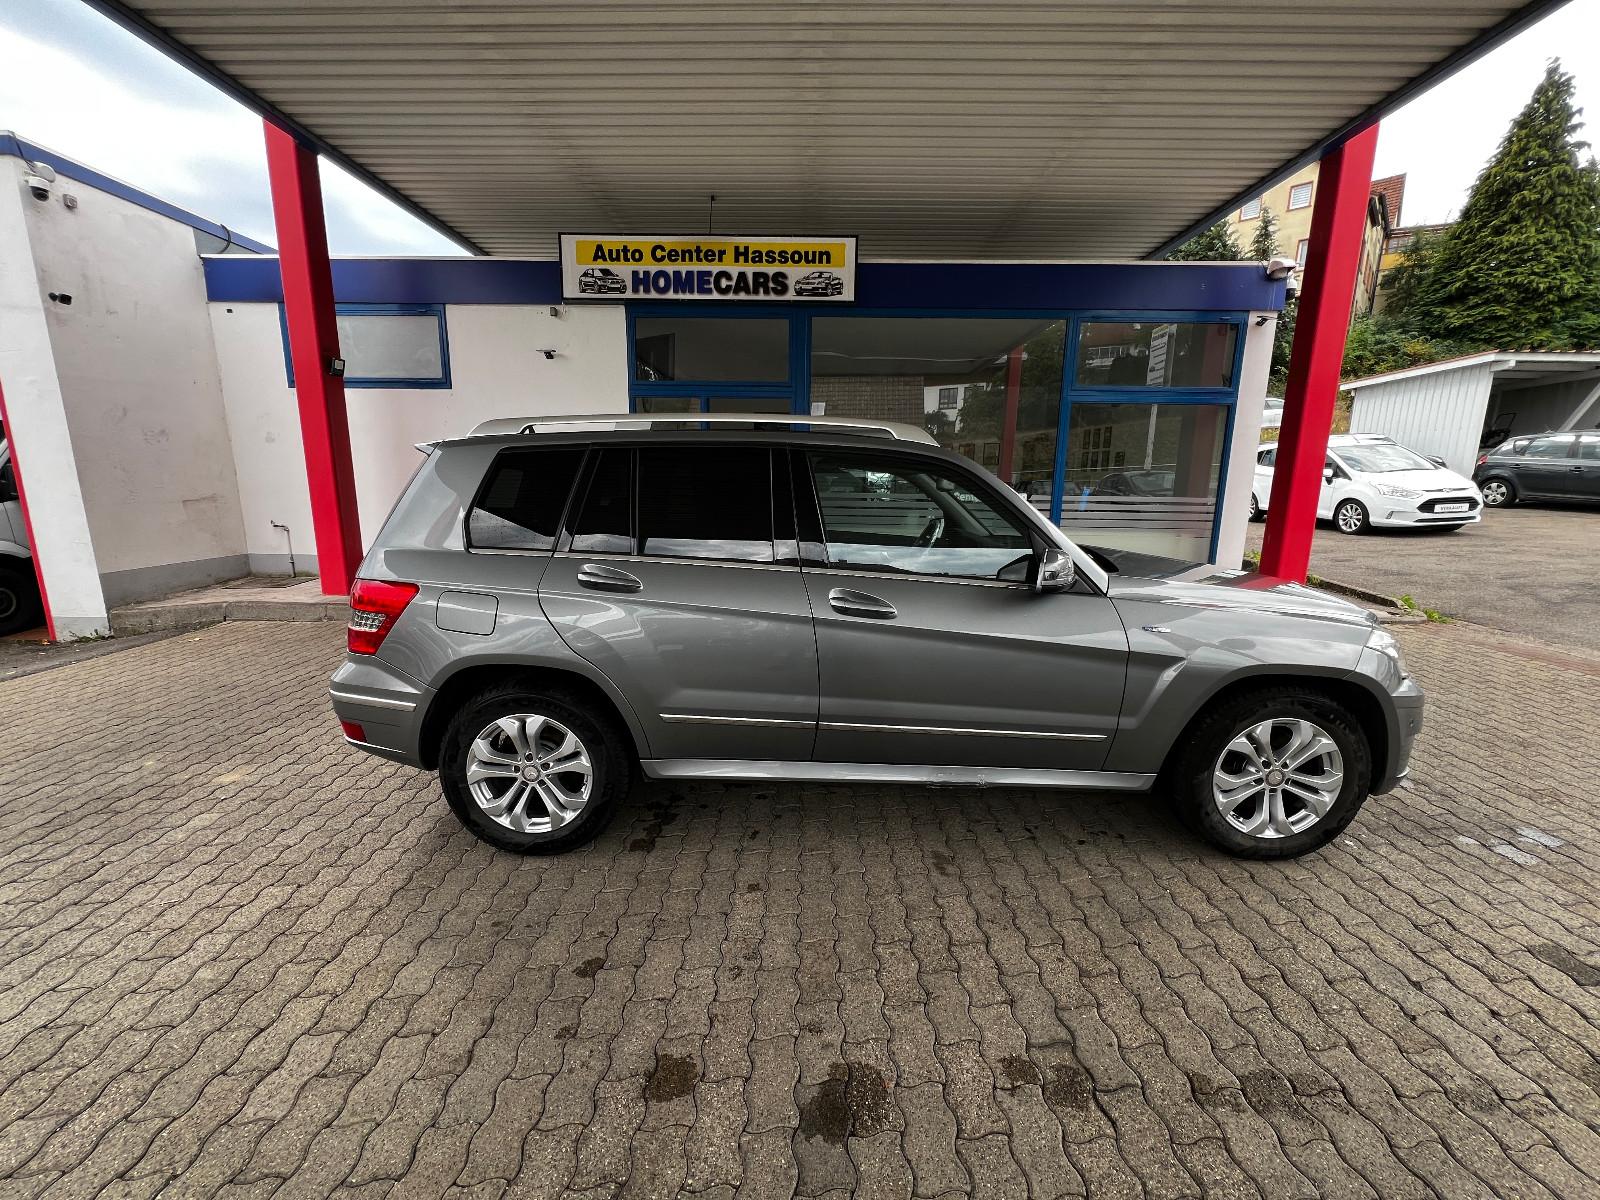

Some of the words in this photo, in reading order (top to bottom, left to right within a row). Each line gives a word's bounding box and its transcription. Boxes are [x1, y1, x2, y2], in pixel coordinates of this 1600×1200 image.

[592, 244, 643, 262] Auto
[651, 244, 727, 263] Center
[734, 246, 832, 265] Hassoun
[631, 270, 788, 296] HOMECARS
